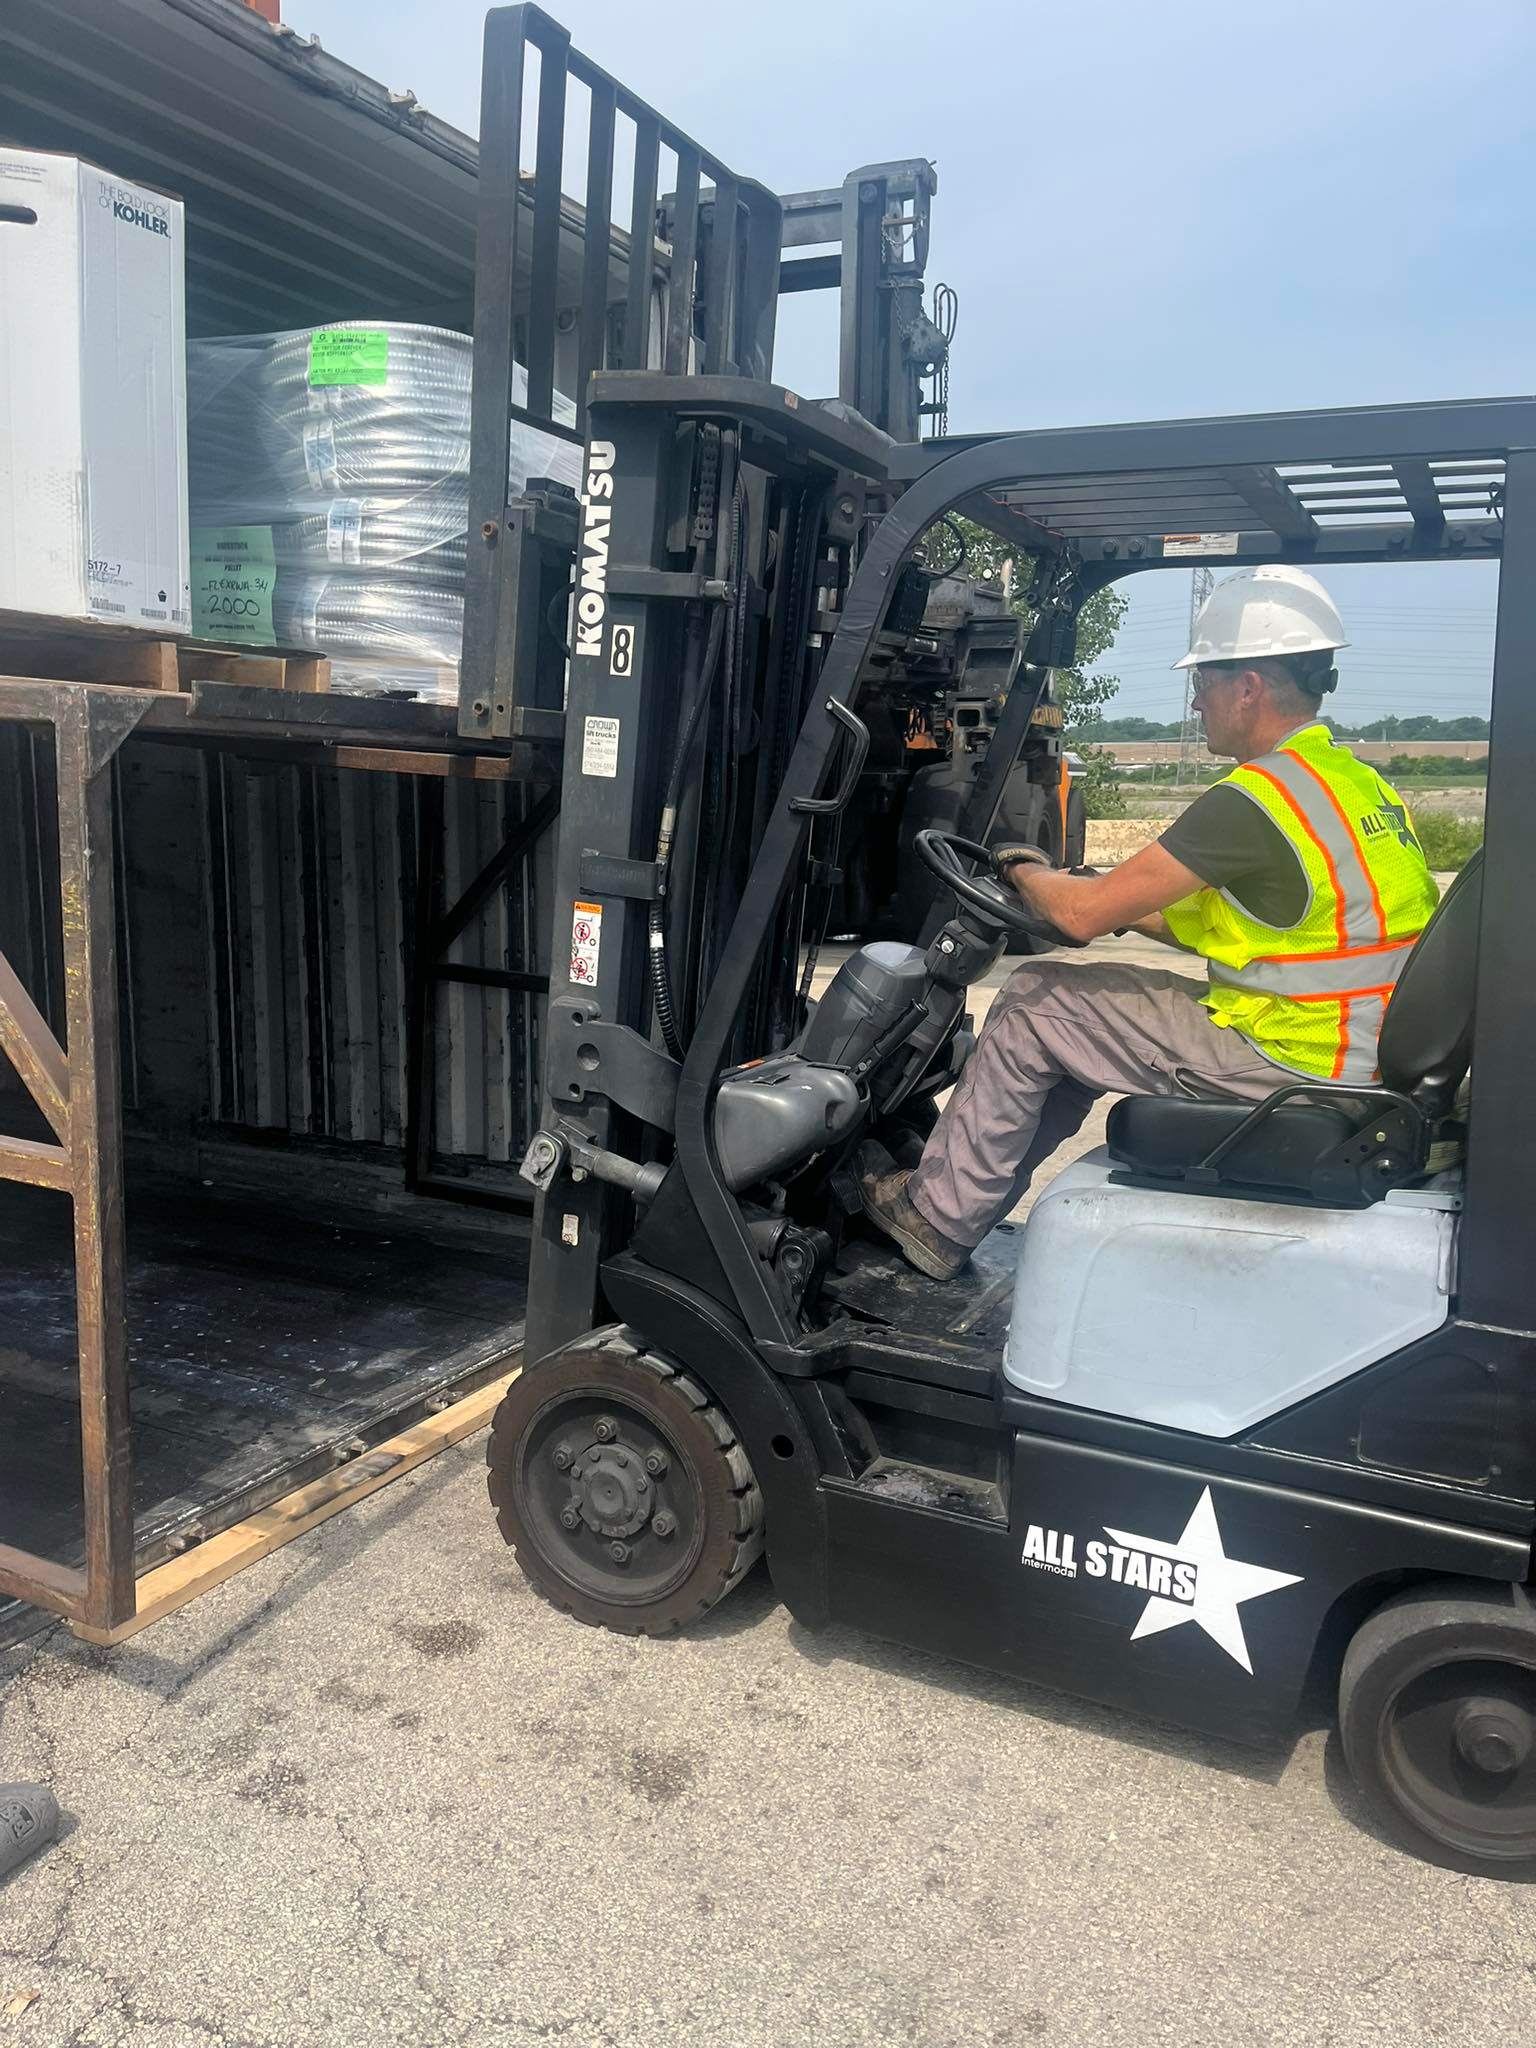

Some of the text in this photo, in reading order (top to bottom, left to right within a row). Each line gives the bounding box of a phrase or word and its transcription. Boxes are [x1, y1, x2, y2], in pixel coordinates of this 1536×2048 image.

[98, 180, 116, 200] THE
[576, 440, 616, 657] KOMATSU
[87, 559, 122, 576] 5172-7
[208, 594, 260, 617] 2000
[612, 627, 631, 674] 8
[595, 731, 616, 739] trucks
[1360, 813, 1386, 836] ALL
[1021, 1555, 1077, 1579] Intermodal
[1022, 1524, 1197, 1603] ALL STARS
